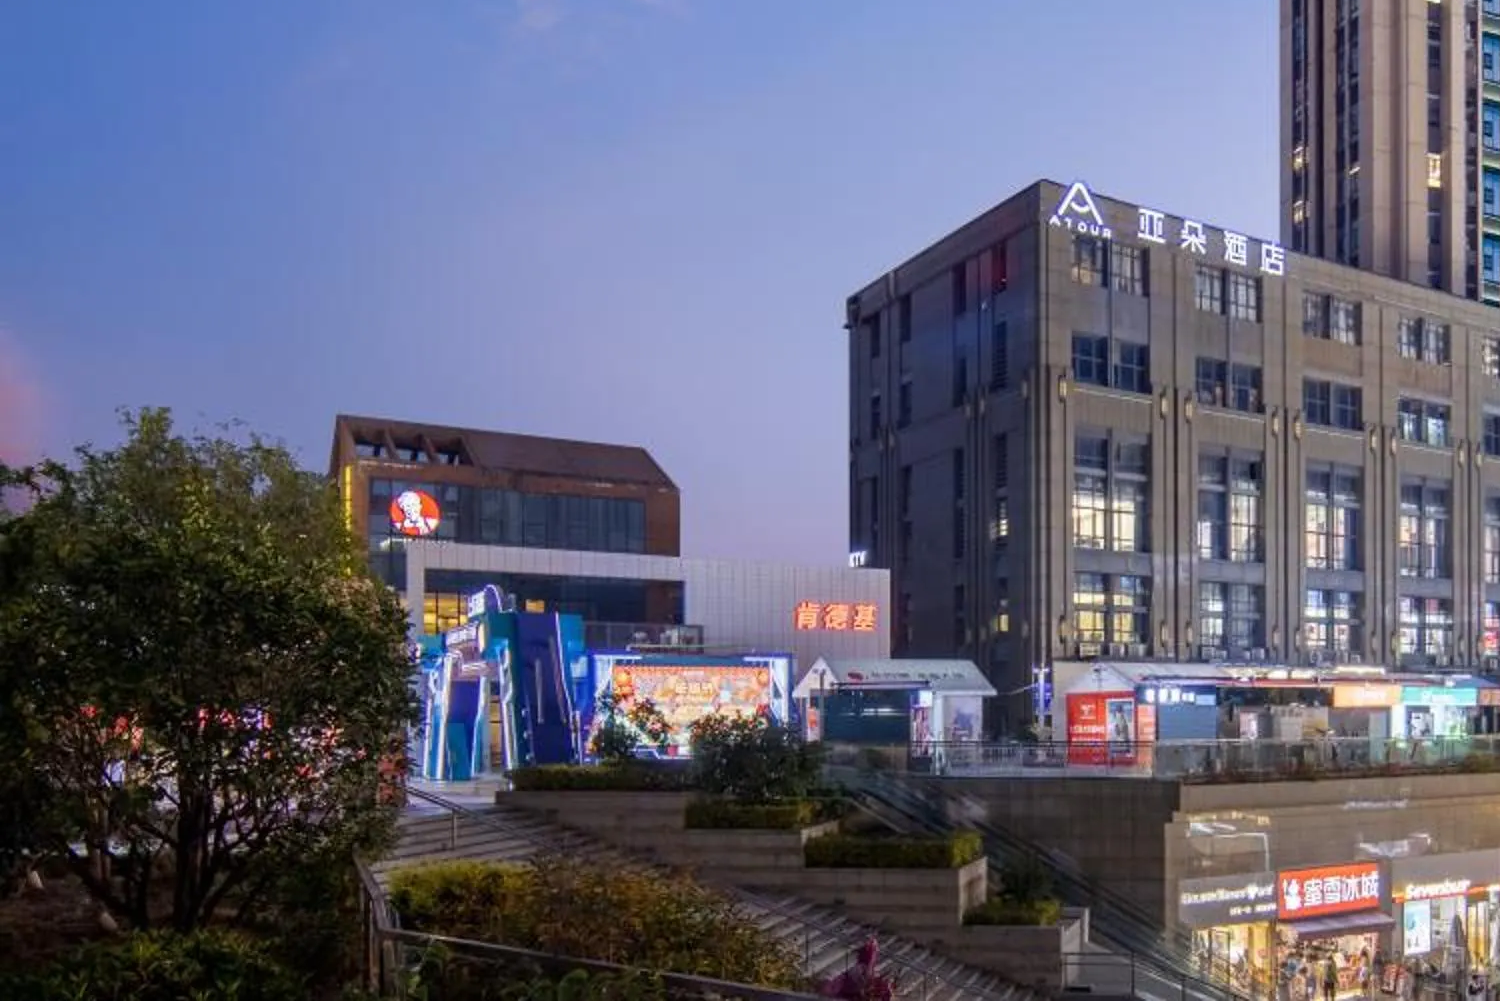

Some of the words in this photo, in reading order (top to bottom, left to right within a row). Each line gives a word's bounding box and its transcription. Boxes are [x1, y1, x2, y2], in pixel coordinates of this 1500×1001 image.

[1049, 215, 1112, 239] ATOUR
[1137, 208, 1285, 276] 亚朵酒店
[797, 600, 878, 630] 肯德基
[1303, 871, 1379, 907] 蜜雪冰城
